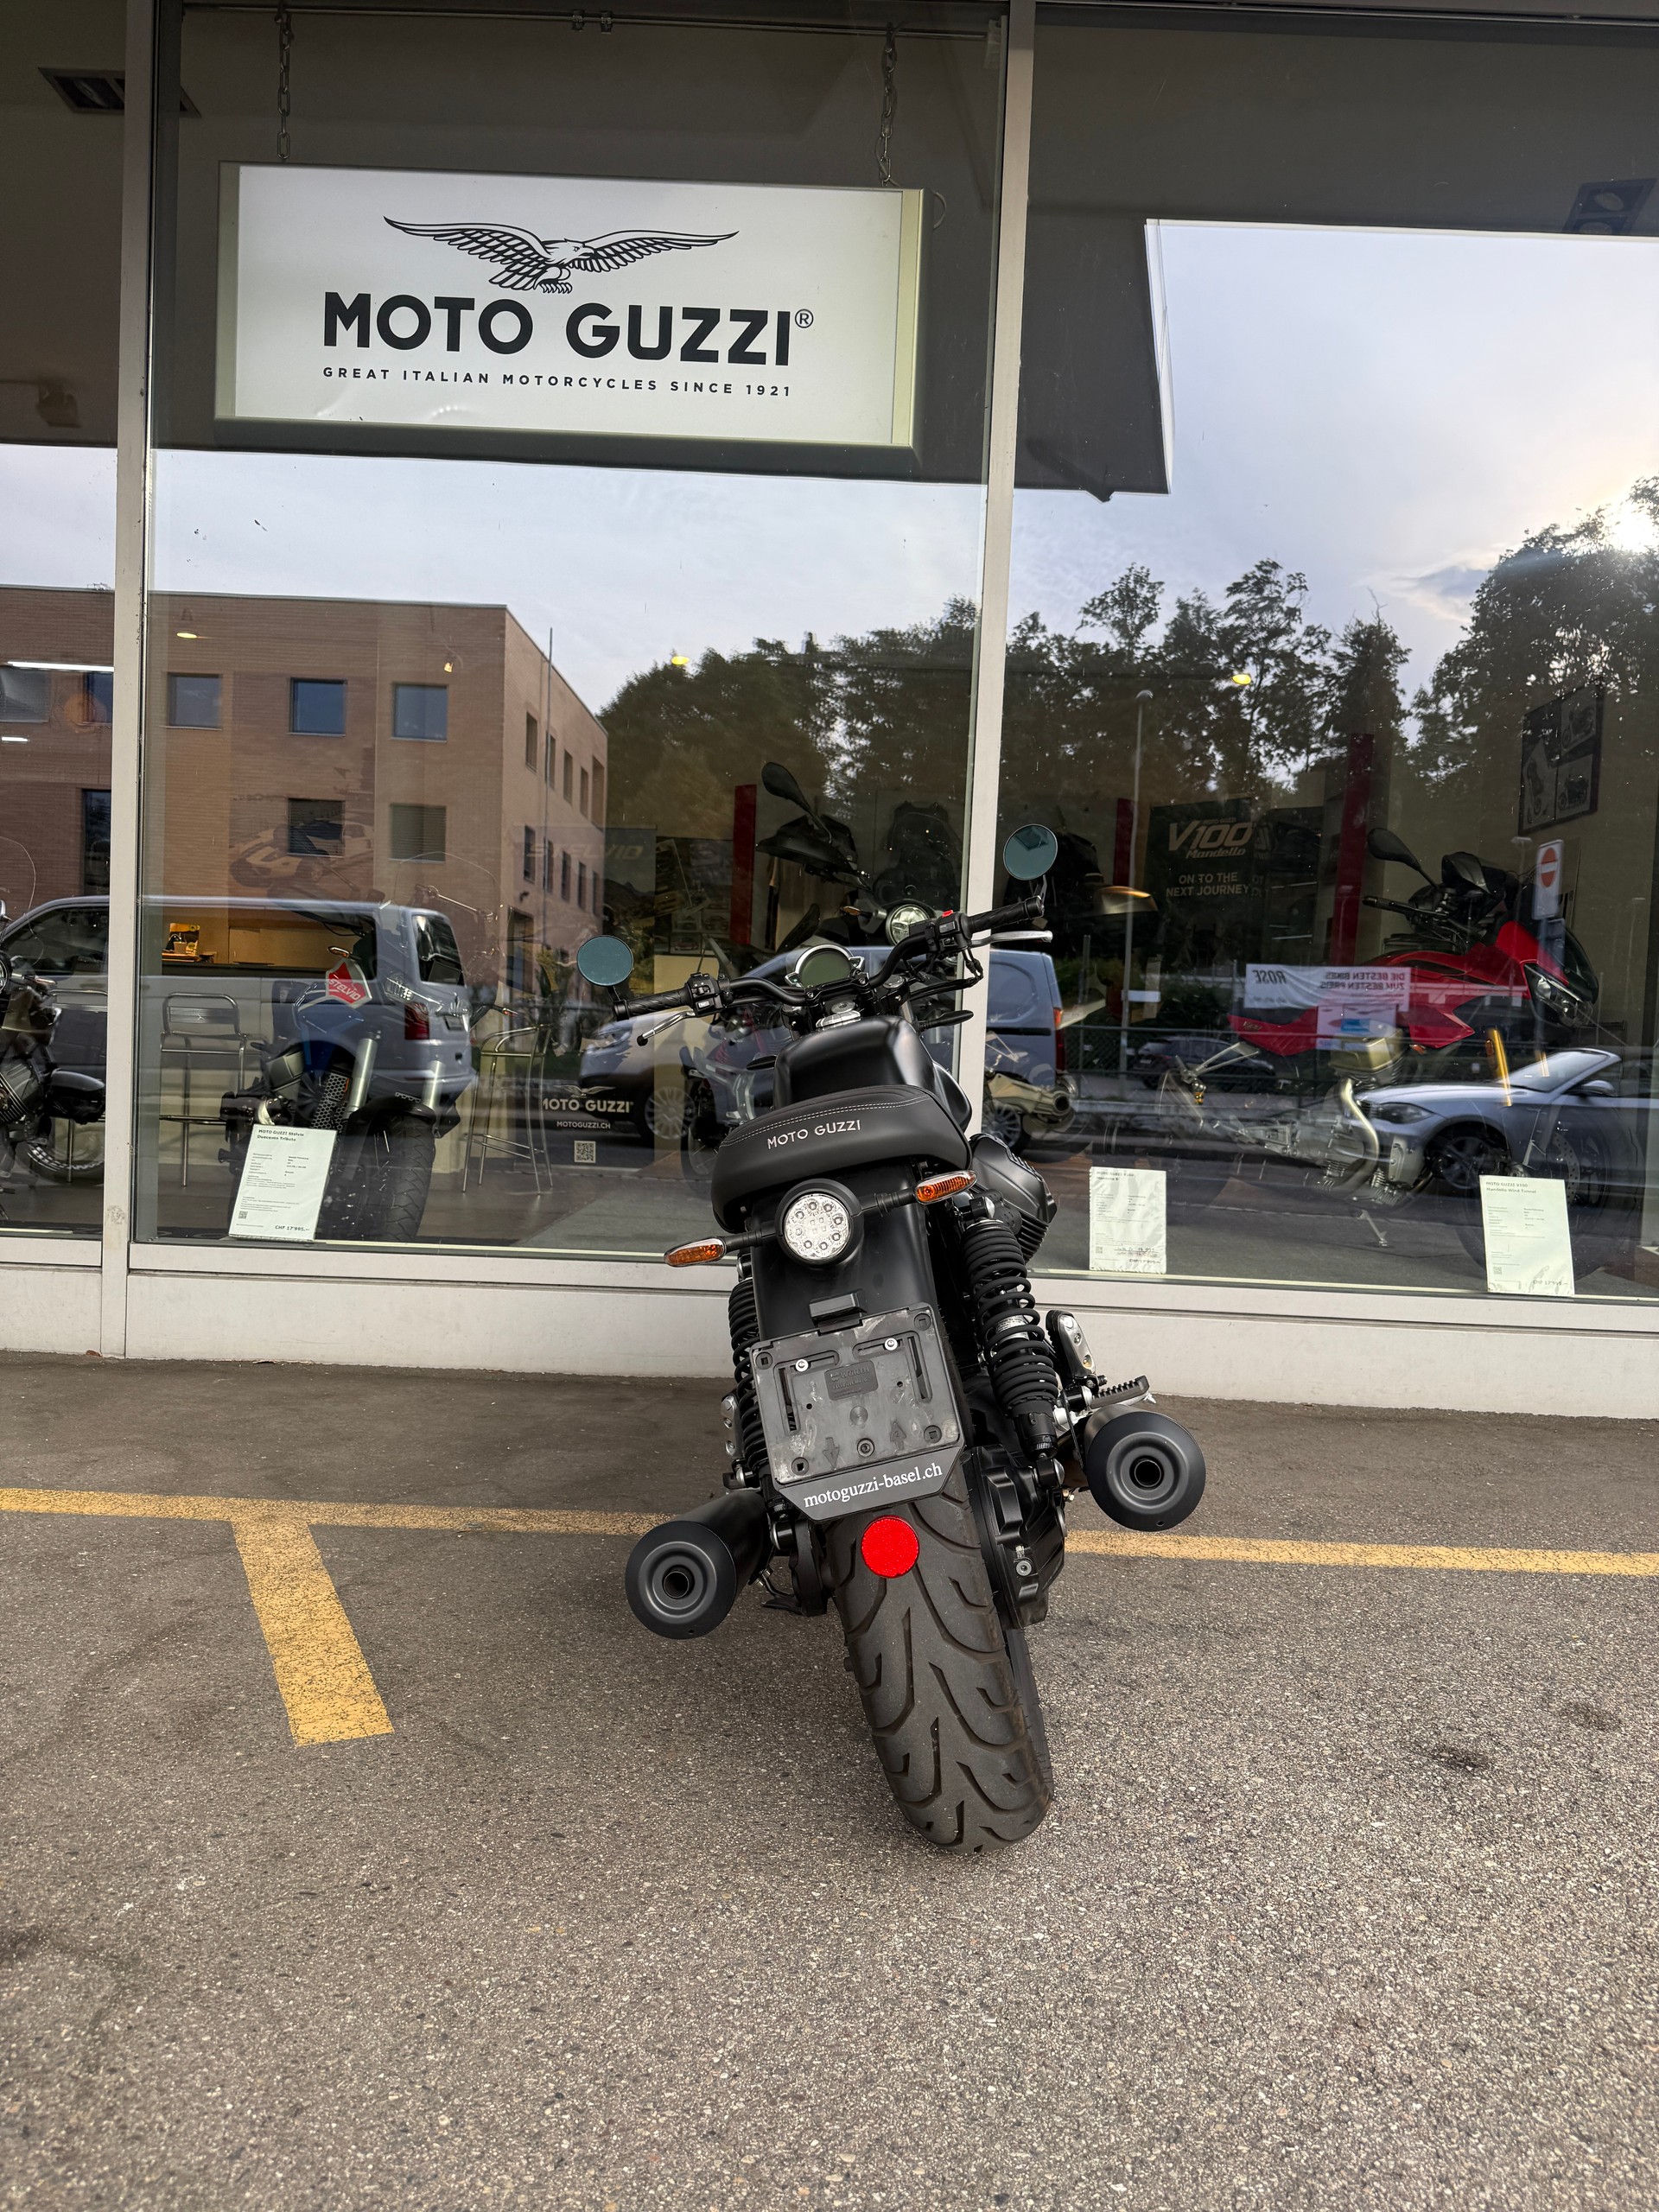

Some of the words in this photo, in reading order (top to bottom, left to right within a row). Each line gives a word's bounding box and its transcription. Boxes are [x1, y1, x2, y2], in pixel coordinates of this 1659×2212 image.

[324, 291, 533, 355] MOTO
[322, 366, 391, 380] GREAT
[403, 370, 489, 384] ITALIAN
[502, 374, 657, 391] MOTORCYCLES
[671, 380, 733, 395] SINCE
[746, 385, 791, 397] 1921
[1168, 819, 1254, 852] V100
[1185, 847, 1246, 859] Mandello
[1166, 886, 1194, 898] NEXT
[1197, 884, 1249, 896] JOURNEY
[1179, 874, 1195, 885] ON
[1198, 874, 1214, 884] TO
[1217, 872, 1238, 883] THE
[328, 978, 361, 1001] STELVIO
[556, 1121, 611, 1129] MOTOGUZZI.CH
[767, 1128, 809, 1150] MOTO
[814, 1119, 861, 1135] GUZZI
[804, 1462, 944, 1508] motoguzzi-basel.ch
